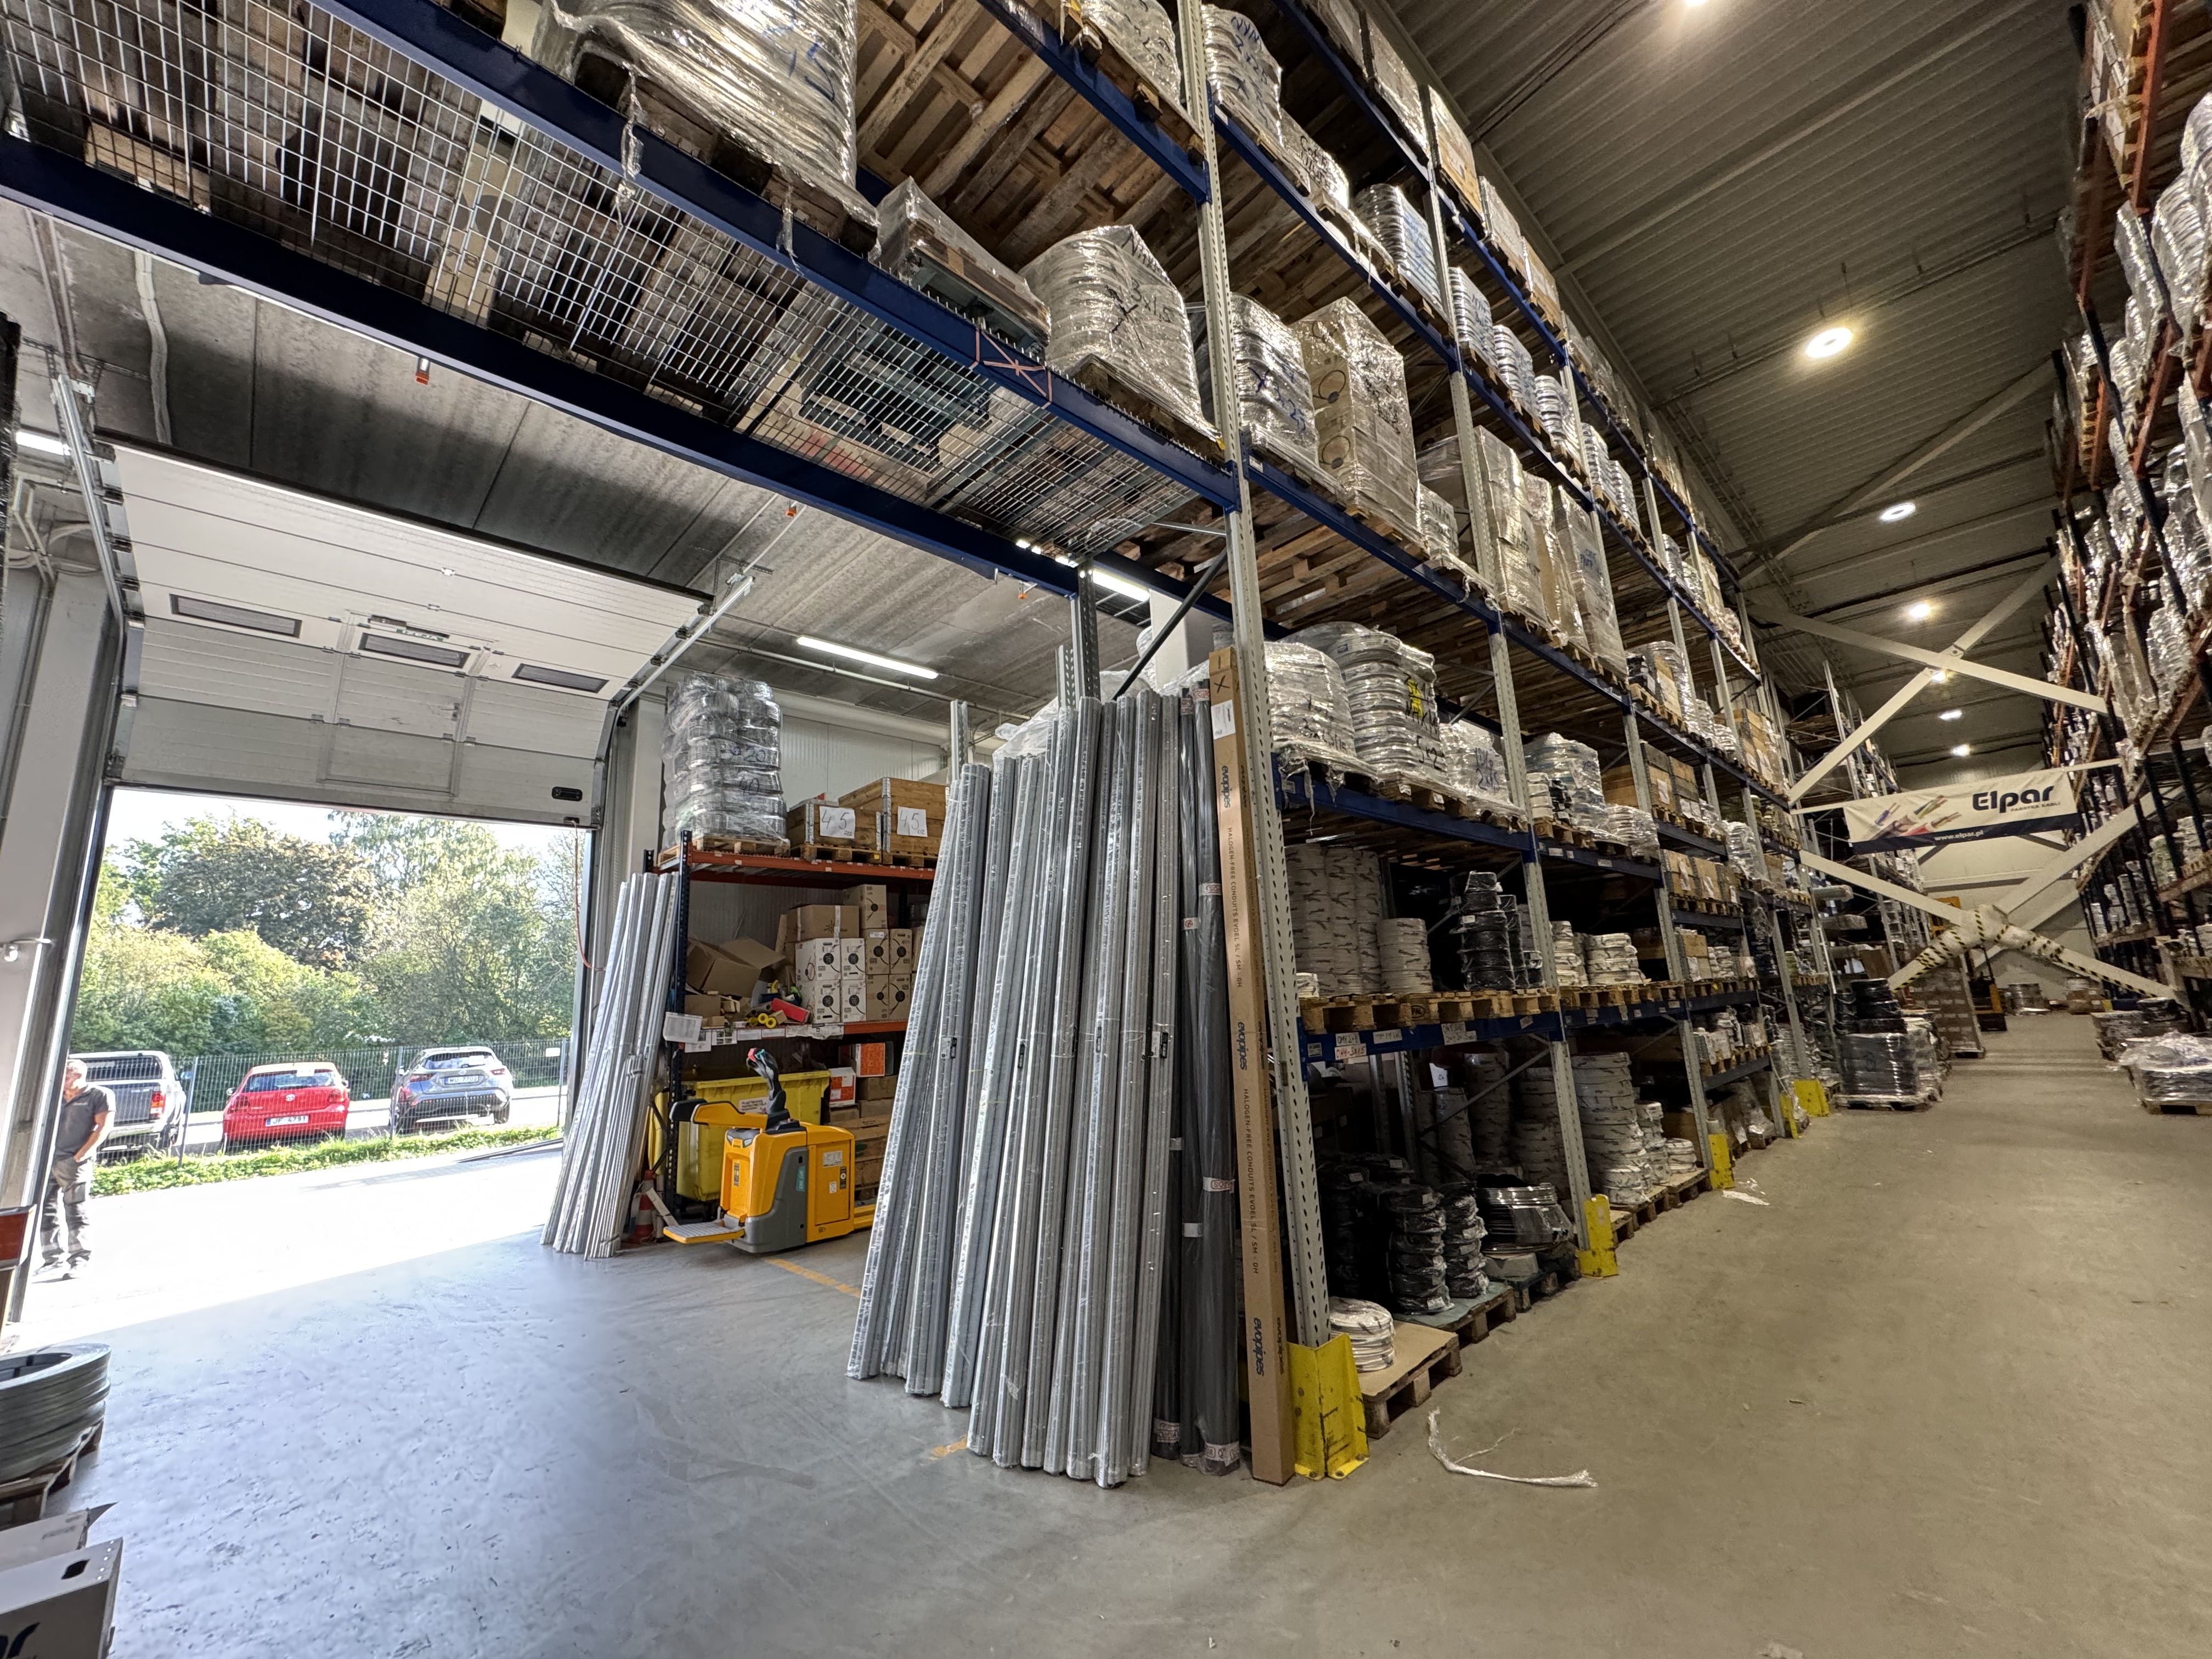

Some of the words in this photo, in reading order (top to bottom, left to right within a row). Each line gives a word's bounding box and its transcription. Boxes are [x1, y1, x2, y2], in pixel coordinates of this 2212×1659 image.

[1221, 765, 1233, 809] evopipes
[1973, 786, 2055, 814] Elpar
[1227, 827, 1236, 879] HALOGEN-FREE
[1934, 830, 1984, 842] www.elpar.pl
[1237, 1022, 1249, 1070] evopipes
[1244, 1088, 1252, 1148] HALOGEN-FREE
[1246, 1151, 1255, 1192] CONDUITS
[1252, 1317, 1266, 1377] evopipes
